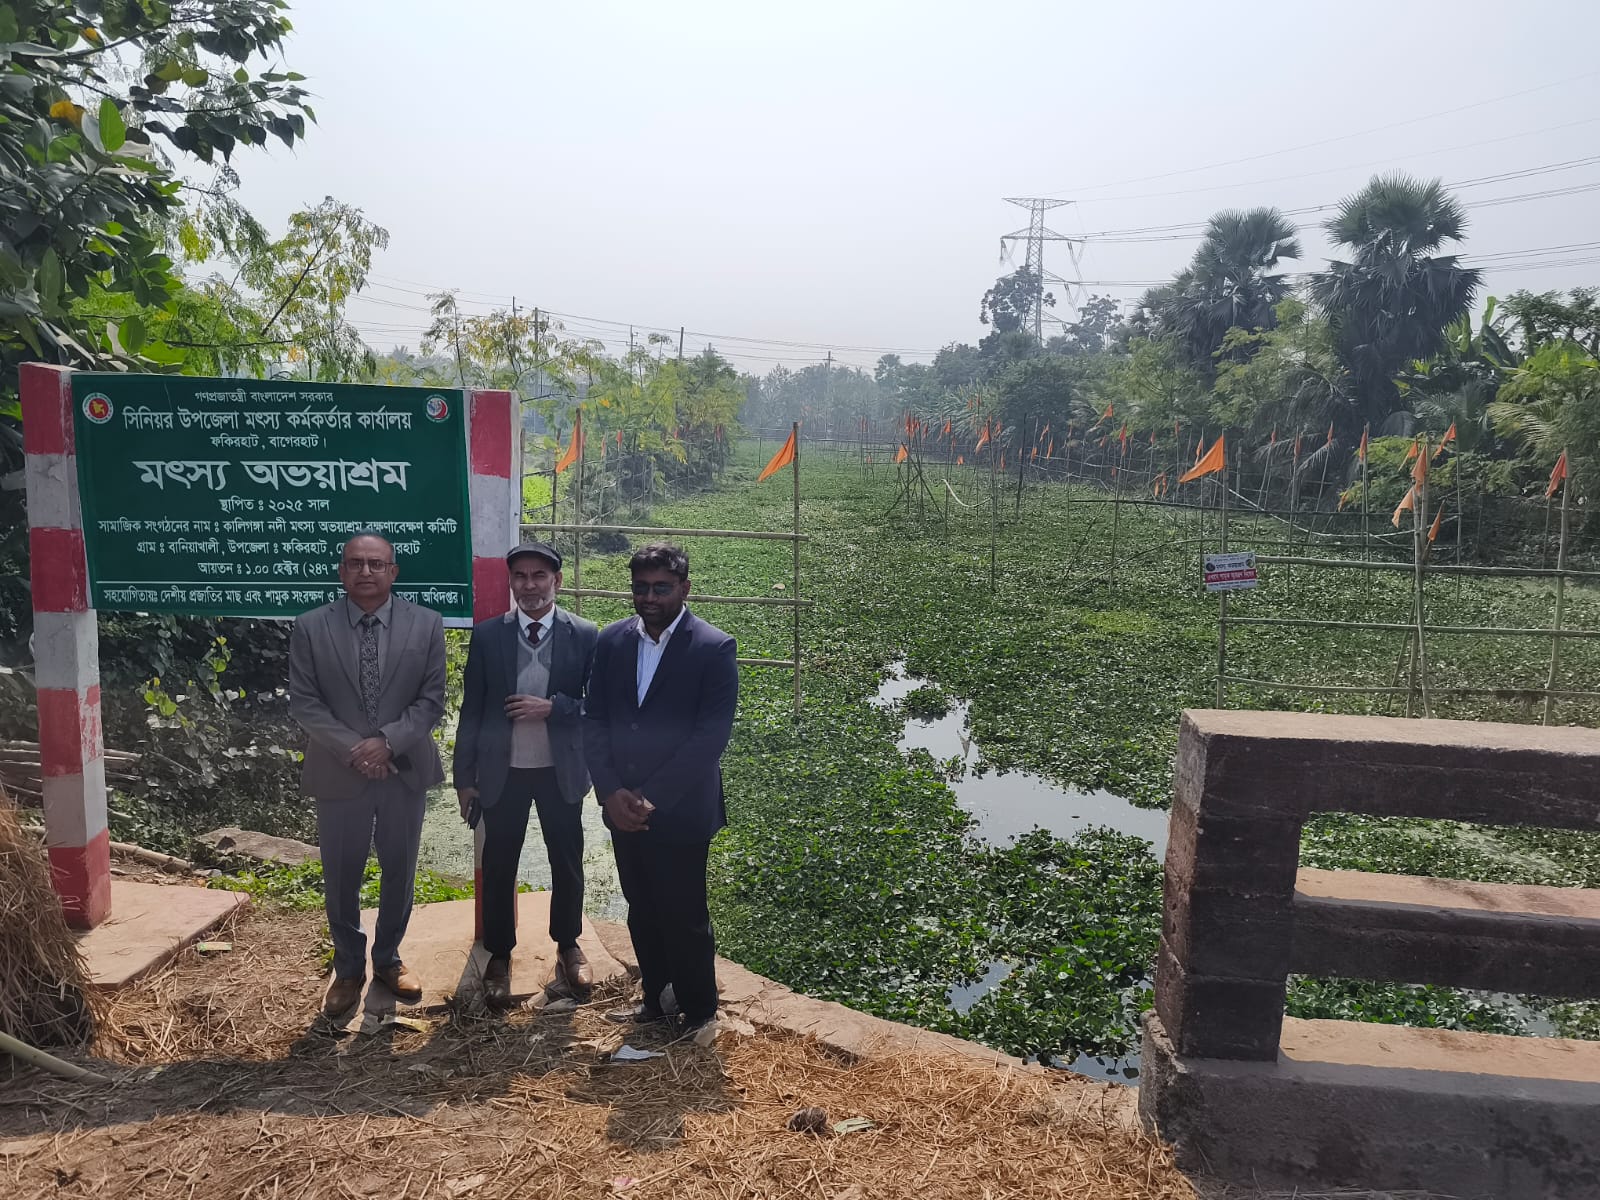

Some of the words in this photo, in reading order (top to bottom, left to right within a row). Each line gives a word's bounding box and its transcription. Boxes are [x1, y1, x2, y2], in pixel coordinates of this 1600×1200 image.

[251, 392, 296, 402] বাংলাদেশ
[300, 392, 333, 401] সরকার
[123, 406, 173, 429] সিনিয়র
[177, 406, 239, 429] উপজেলা
[244, 412, 280, 429] মৎস্য
[286, 405, 352, 429] কর্মকর্তার
[356, 405, 412, 430] কার্যালয়
[132, 461, 231, 490] মৎস্য
[240, 458, 411, 493] অভয়াশ্রম
[219, 496, 254, 512] স্থাপিত
[269, 500, 303, 512] ২০২৫
[308, 500, 329, 510] সাল
[98, 518, 141, 532] সামাজিক
[145, 517, 189, 533] সংগঠনের
[193, 521, 210, 532] নাম
[267, 518, 286, 532] নদী
[289, 521, 315, 533] মৎস্য
[319, 521, 363, 533] অভয়াশ্রম
[427, 518, 457, 533] কমিটি
[137, 542, 155, 553] গ্রাম
[227, 540, 269, 553] উপজেলা
[198, 563, 233, 574] আয়তন
[246, 563, 268, 574] ১.০০
[161, 585, 186, 602] দেশীয়
[189, 586, 222, 603] প্রজাতির
[226, 590, 242, 603] মাছ
[245, 591, 262, 604] এবং
[265, 590, 289, 606] শামুক
[292, 590, 324, 604] সংরক্ষণ
[328, 592, 334, 603] ও
